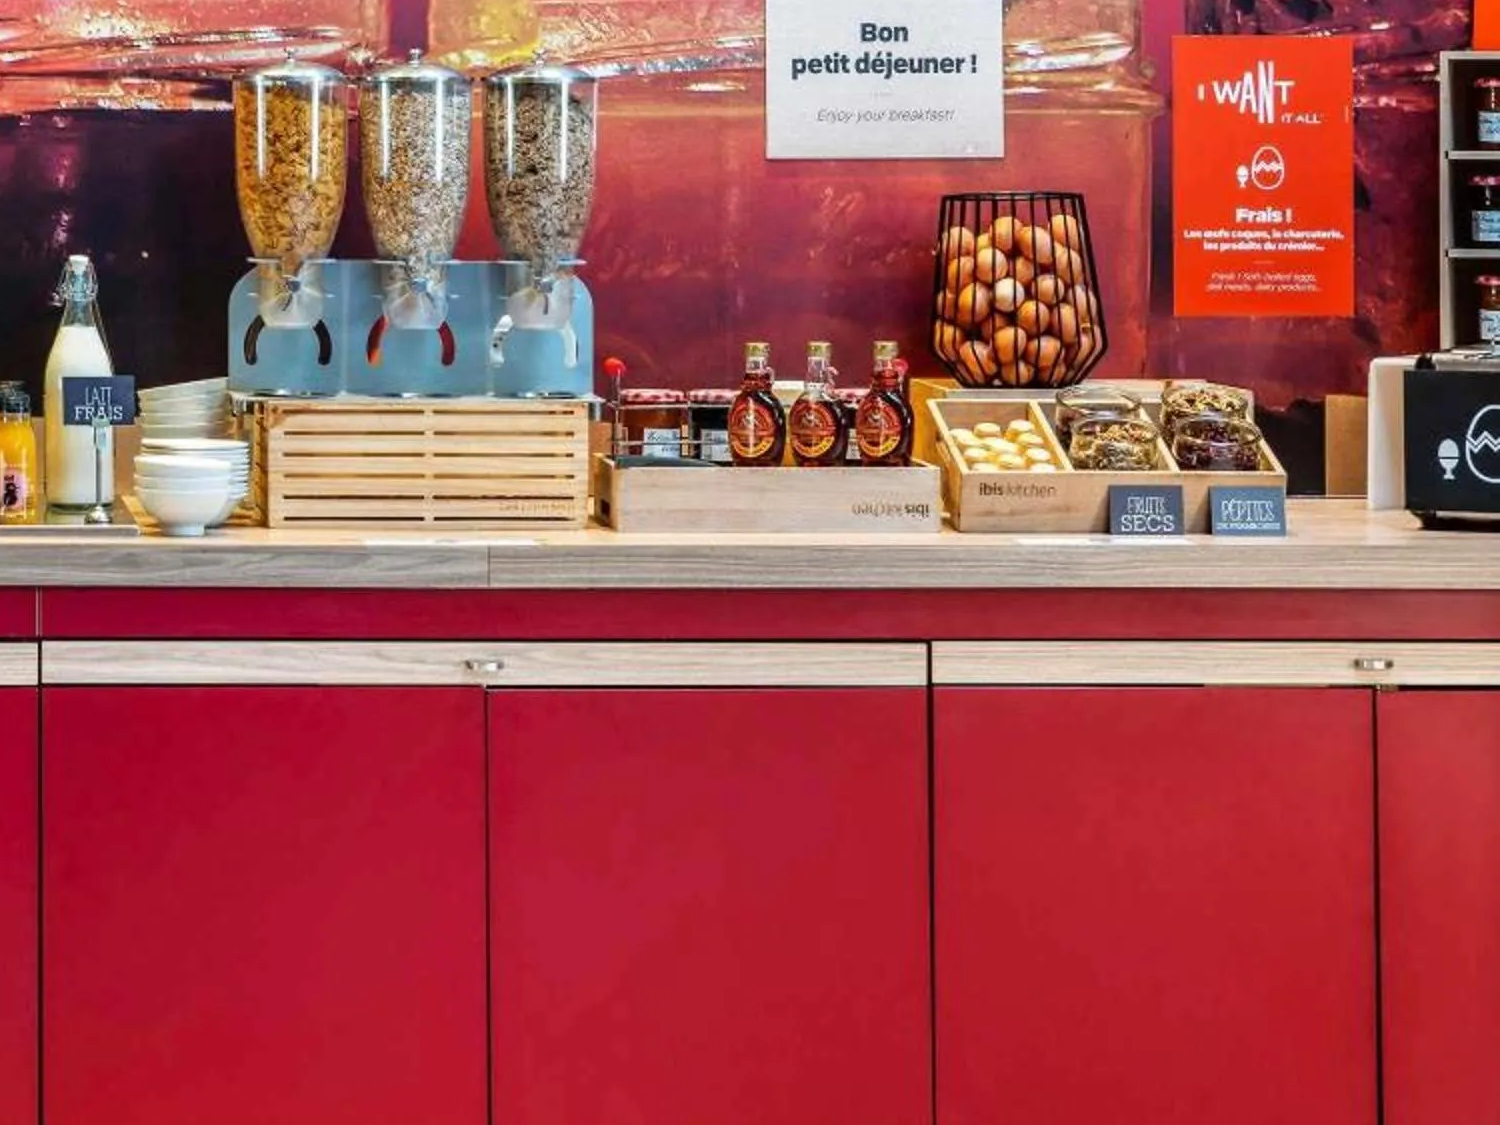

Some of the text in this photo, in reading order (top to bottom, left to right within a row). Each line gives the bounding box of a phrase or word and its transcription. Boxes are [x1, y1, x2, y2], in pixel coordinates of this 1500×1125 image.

[860, 23, 909, 43] Bon
[791, 51, 978, 80] petit déjeuner !
[1197, 60, 1296, 124] I WANT
[816, 108, 852, 124] Enjoy
[856, 111, 885, 124] your
[1281, 113, 1321, 124] IT ALL
[1235, 207, 1293, 223] Frais !
[85, 386, 112, 406] LAIT
[74, 405, 123, 420] FRAIS
[979, 482, 1003, 496] ibis
[1127, 496, 1166, 514] FRUITS
[1221, 498, 1275, 522] PÉPITES
[1121, 514, 1175, 532] SECS
